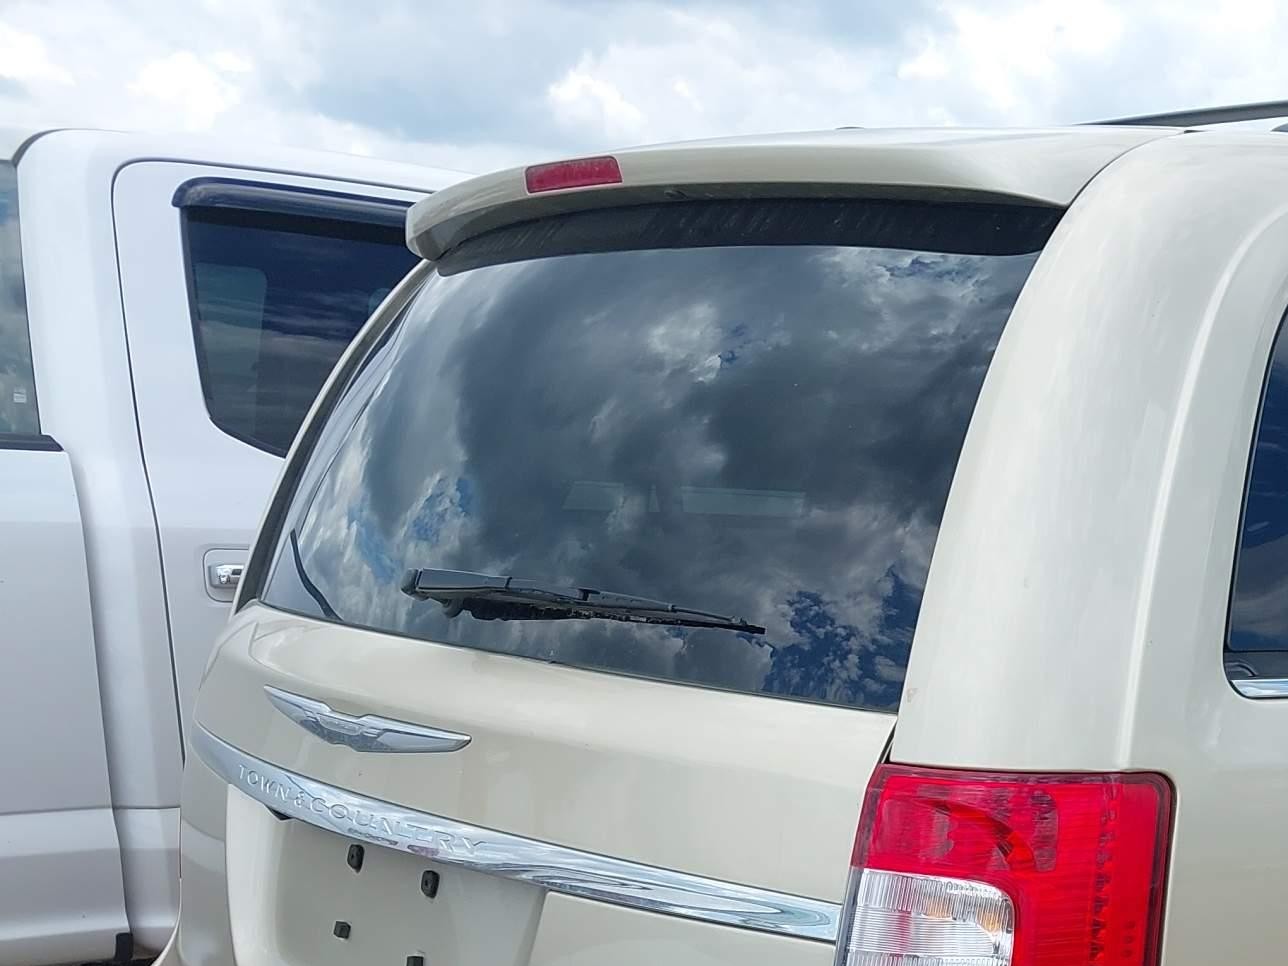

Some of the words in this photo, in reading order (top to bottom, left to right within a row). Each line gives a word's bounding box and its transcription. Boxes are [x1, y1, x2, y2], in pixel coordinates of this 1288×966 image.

[238, 764, 292, 802] TOWN
[294, 787, 306, 809] &
[309, 796, 489, 856] COUNTRY
